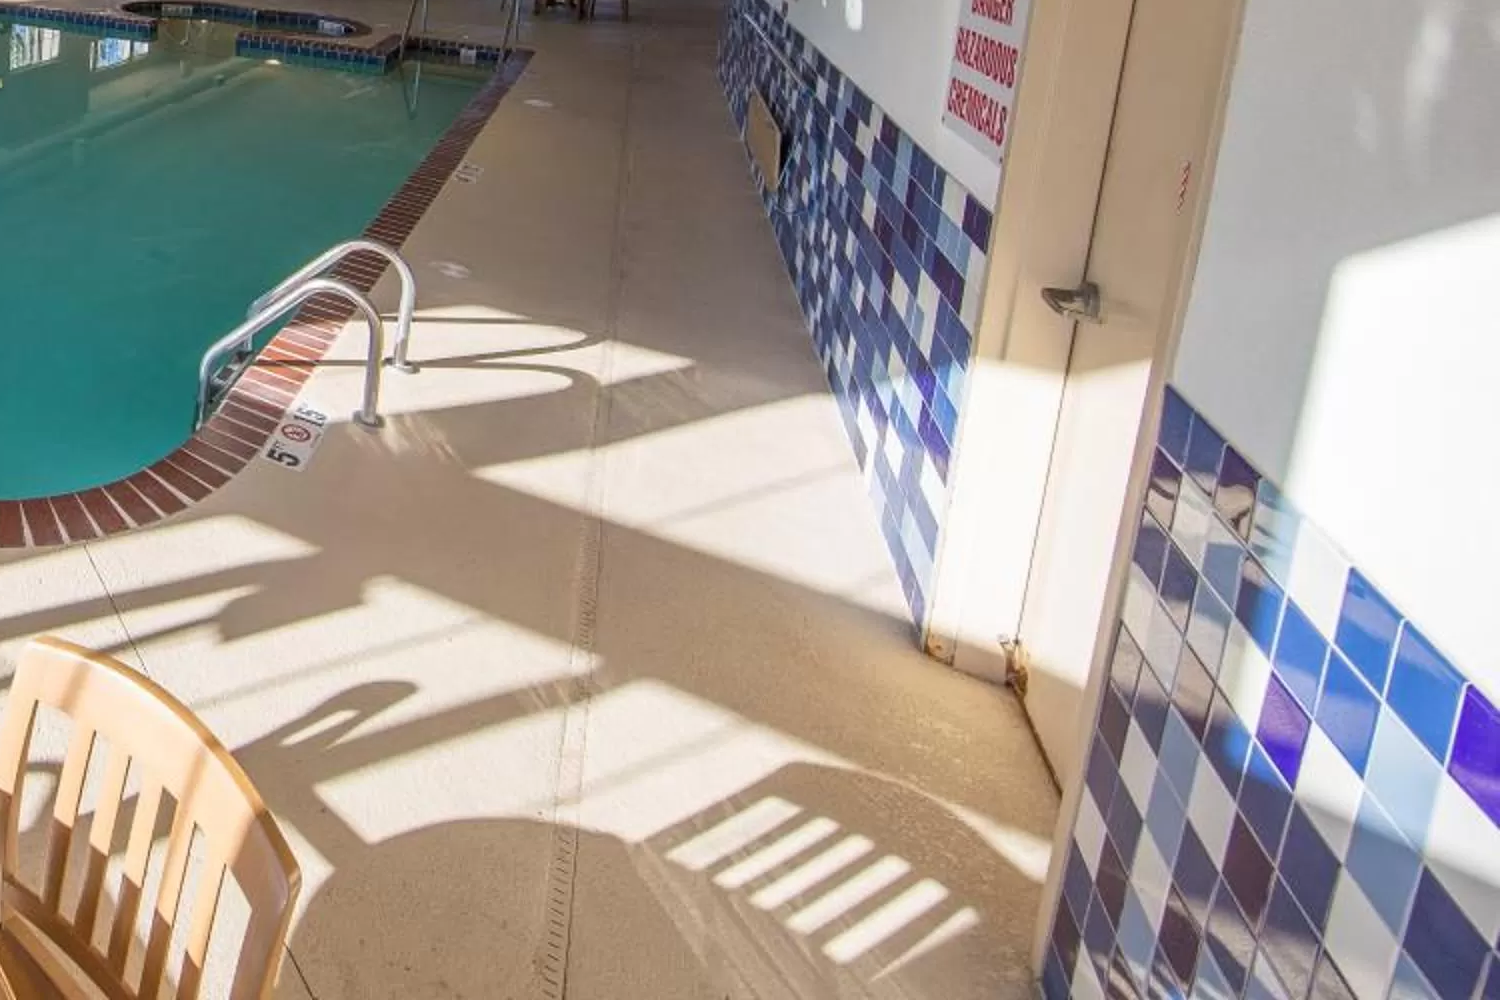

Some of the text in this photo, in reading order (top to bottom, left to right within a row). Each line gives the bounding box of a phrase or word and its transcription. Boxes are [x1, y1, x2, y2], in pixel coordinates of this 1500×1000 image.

[955, 27, 1019, 88] HAZARDOUS
[947, 77, 1007, 146] CHEMICALS
[266, 448, 300, 467] 5
